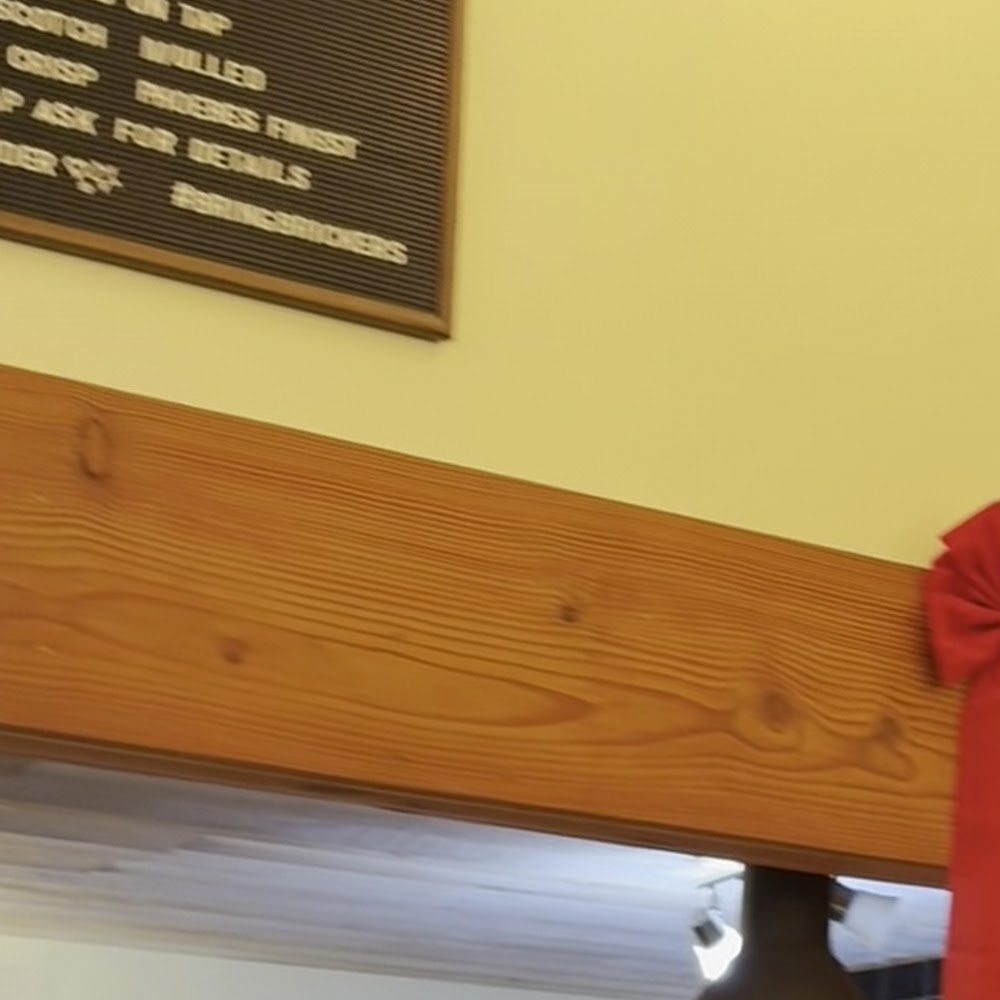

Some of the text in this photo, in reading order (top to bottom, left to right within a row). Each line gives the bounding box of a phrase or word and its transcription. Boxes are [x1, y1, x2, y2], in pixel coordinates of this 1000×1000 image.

[7, 45, 98, 86] CRISP
[140, 36, 266, 90] MULLED
[32, 99, 99, 135] ASK
[114, 118, 178, 155] FOR
[188, 138, 311, 189] DETAILS
